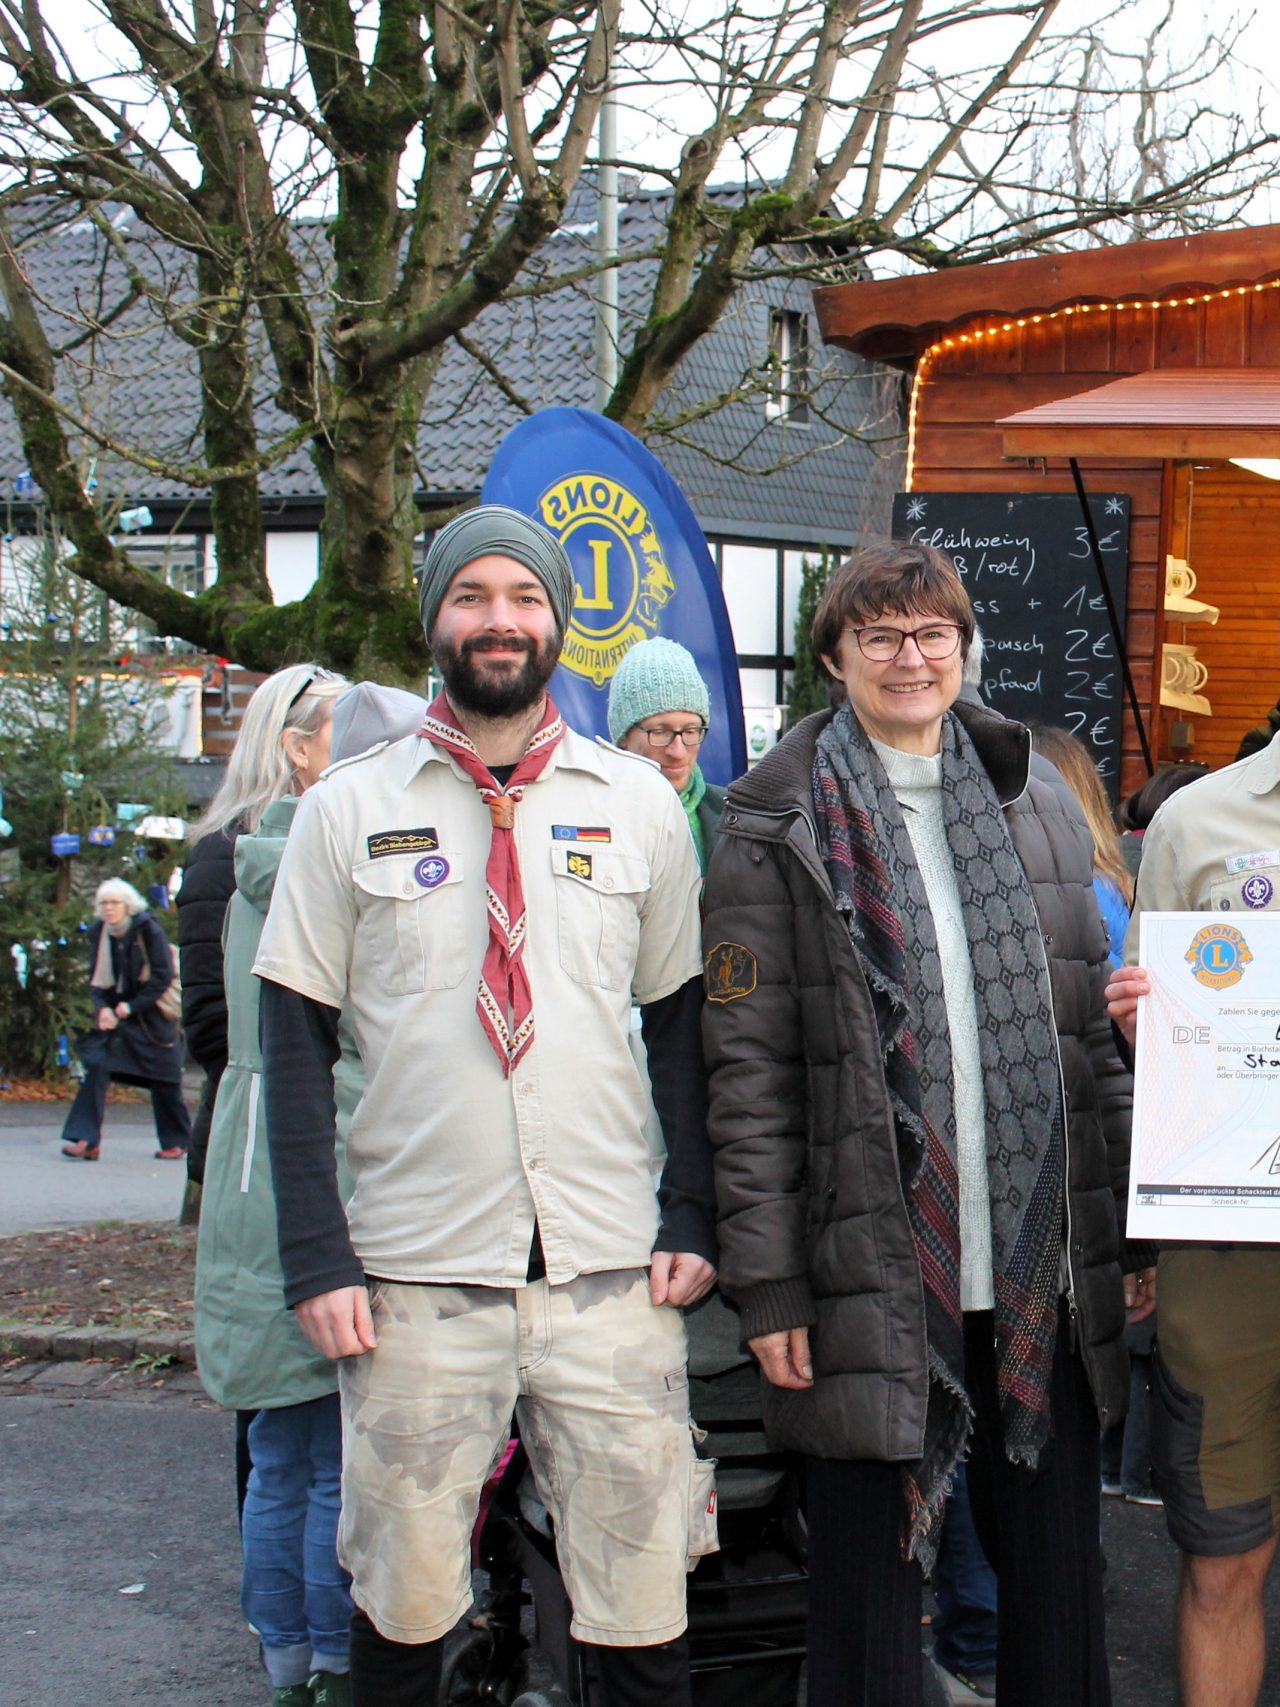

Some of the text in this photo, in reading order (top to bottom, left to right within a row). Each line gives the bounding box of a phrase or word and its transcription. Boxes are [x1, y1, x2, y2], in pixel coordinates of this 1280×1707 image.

[1200, 926, 1239, 940] LIONS
[1211, 944, 1229, 967] L
[1218, 1007, 1245, 1016] Zahlen
[1247, 1007, 1258, 1016] Sie
[1172, 1025, 1211, 1045] DE
[1217, 1045, 1241, 1054] Betrag
[1243, 1045, 1251, 1053] in
[1235, 1071, 1279, 1081] Überbringer
[1193, 1188, 1235, 1196] vorgedruckte
